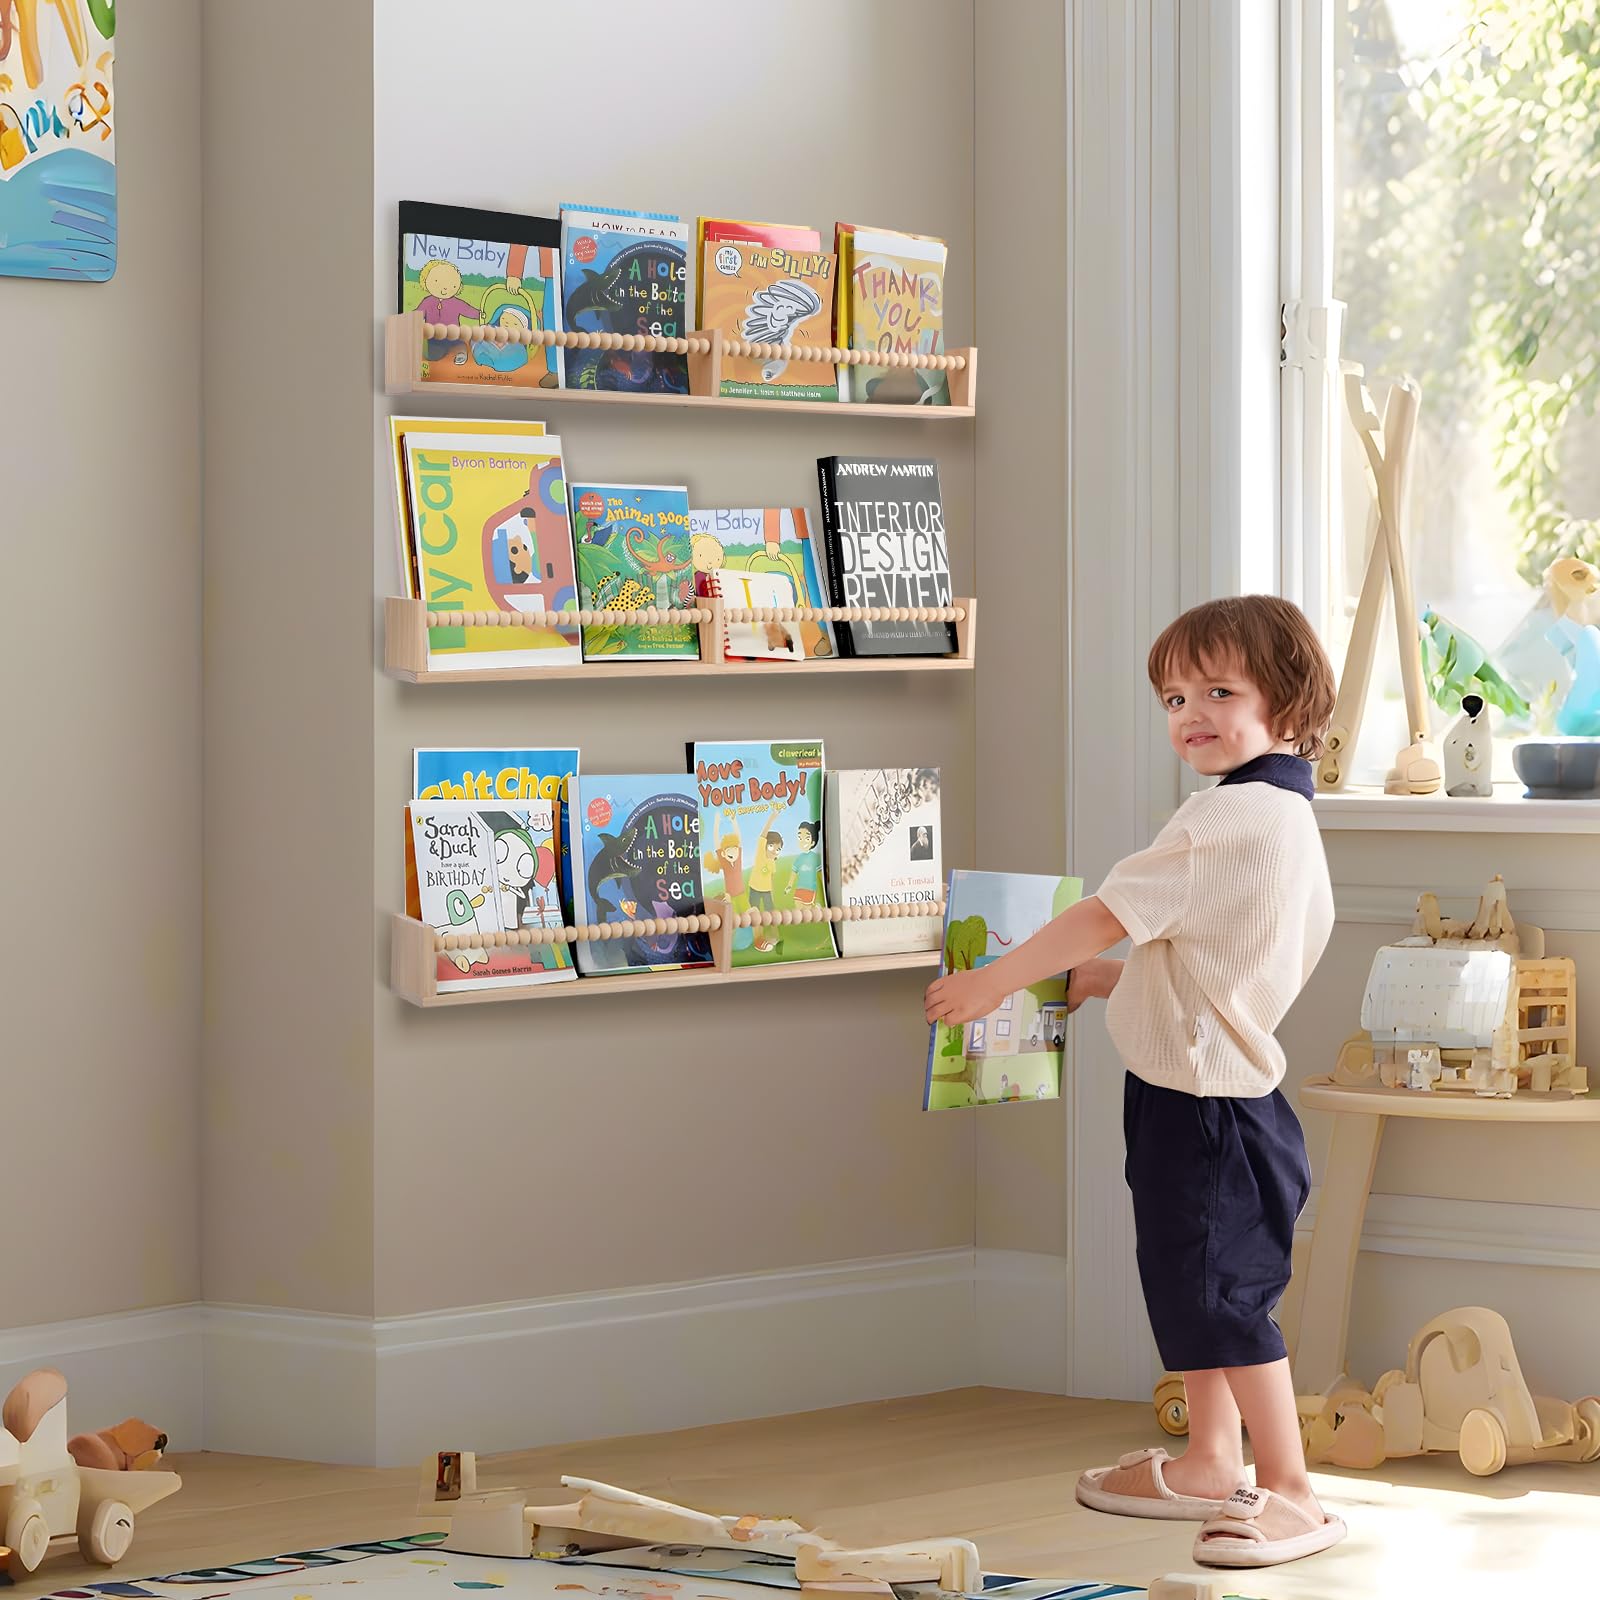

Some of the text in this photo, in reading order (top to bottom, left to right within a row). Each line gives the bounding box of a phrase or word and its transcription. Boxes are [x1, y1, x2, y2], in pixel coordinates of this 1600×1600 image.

[412, 234, 505, 268] New Baby
[719, 253, 738, 266] first
[628, 258, 642, 281] A
[647, 259, 686, 281] Hole
[770, 248, 830, 280] SILLY!
[615, 286, 625, 298] in
[628, 285, 648, 298] the
[852, 261, 938, 313] THANK
[638, 301, 673, 316] of the
[637, 316, 677, 338] Sea
[729, 387, 753, 395] Jennifer
[781, 390, 806, 398] Matthew
[452, 456, 527, 470] Byron Barton
[836, 463, 934, 477] ANDREW MARTIN
[417, 453, 459, 556] Car
[607, 498, 623, 506] The
[606, 506, 657, 528] Animal
[716, 509, 761, 535] Baby
[834, 501, 944, 533] INTERIOR
[840, 532, 949, 572] DESIGN
[843, 573, 953, 611] REVIEW
[698, 771, 807, 807] Your Body!
[424, 816, 480, 839] Sarah
[645, 815, 658, 839] A
[662, 814, 699, 835] Hole
[633, 848, 643, 860] in
[646, 845, 664, 858] the
[426, 868, 486, 887] BIRTHDAY
[657, 860, 690, 875] of the
[656, 878, 695, 900] Sea
[890, 878, 904, 887] Erik
[849, 889, 935, 907] DARWINS TEORI
[472, 968, 490, 977] Sarah
[512, 966, 532, 974] Harris
